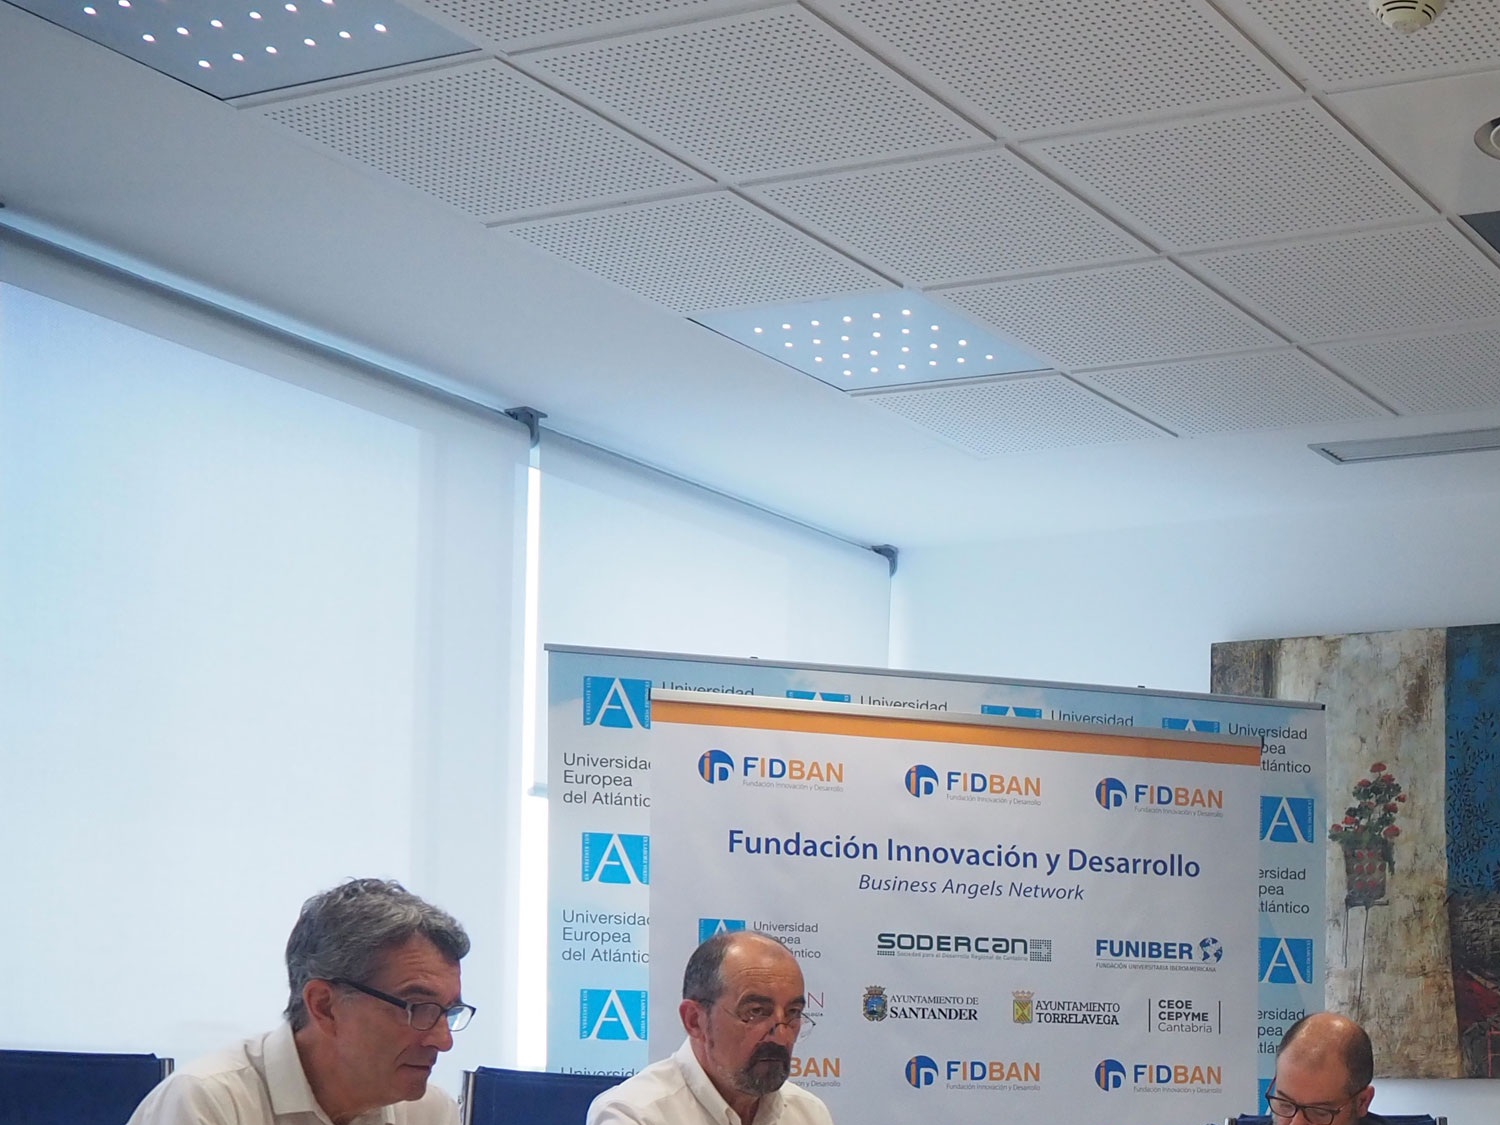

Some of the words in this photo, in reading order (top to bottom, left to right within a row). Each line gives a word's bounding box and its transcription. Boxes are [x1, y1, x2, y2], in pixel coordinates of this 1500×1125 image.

[1051, 709, 1134, 727] Universidad
[1228, 722, 1308, 740] Universidad
[563, 752, 651, 771] Universida
[743, 756, 844, 783] FIDBAN
[1260, 759, 1311, 774] tlántico
[563, 769, 633, 788] Europea
[947, 771, 1041, 797] FIDBAN
[562, 790, 587, 804] del
[592, 791, 651, 807] Atlántic
[1135, 783, 1223, 809] FIDBAN
[728, 829, 878, 860] Fundación
[887, 838, 1038, 869] Innovación
[1045, 850, 1060, 876] y
[1068, 848, 1200, 878] Desarrollo
[859, 873, 937, 895] Business
[942, 878, 1003, 900] Angels
[1008, 881, 1085, 901] Network
[1259, 900, 1310, 914] tlántico
[753, 920, 819, 933] Universidad
[562, 927, 631, 945] Europea
[561, 947, 586, 961] del
[591, 948, 650, 964] Atlántic
[1095, 939, 1193, 960] FUNIBER
[890, 994, 963, 1006] AYUNTAMIENTO
[965, 996, 979, 1006] DE
[1035, 1000, 1120, 1013] AYUNTAMIENTO
[1158, 999, 1193, 1010] CEOE
[889, 1006, 979, 1021] SANTANDER
[1036, 1012, 1120, 1025] TORRELAVEGA
[1158, 1011, 1209, 1022] CEPYME
[1157, 1022, 1213, 1034] Cantabria
[946, 1061, 1040, 1082] FIDBAN
[1133, 1064, 1223, 1085] FIDBAN
